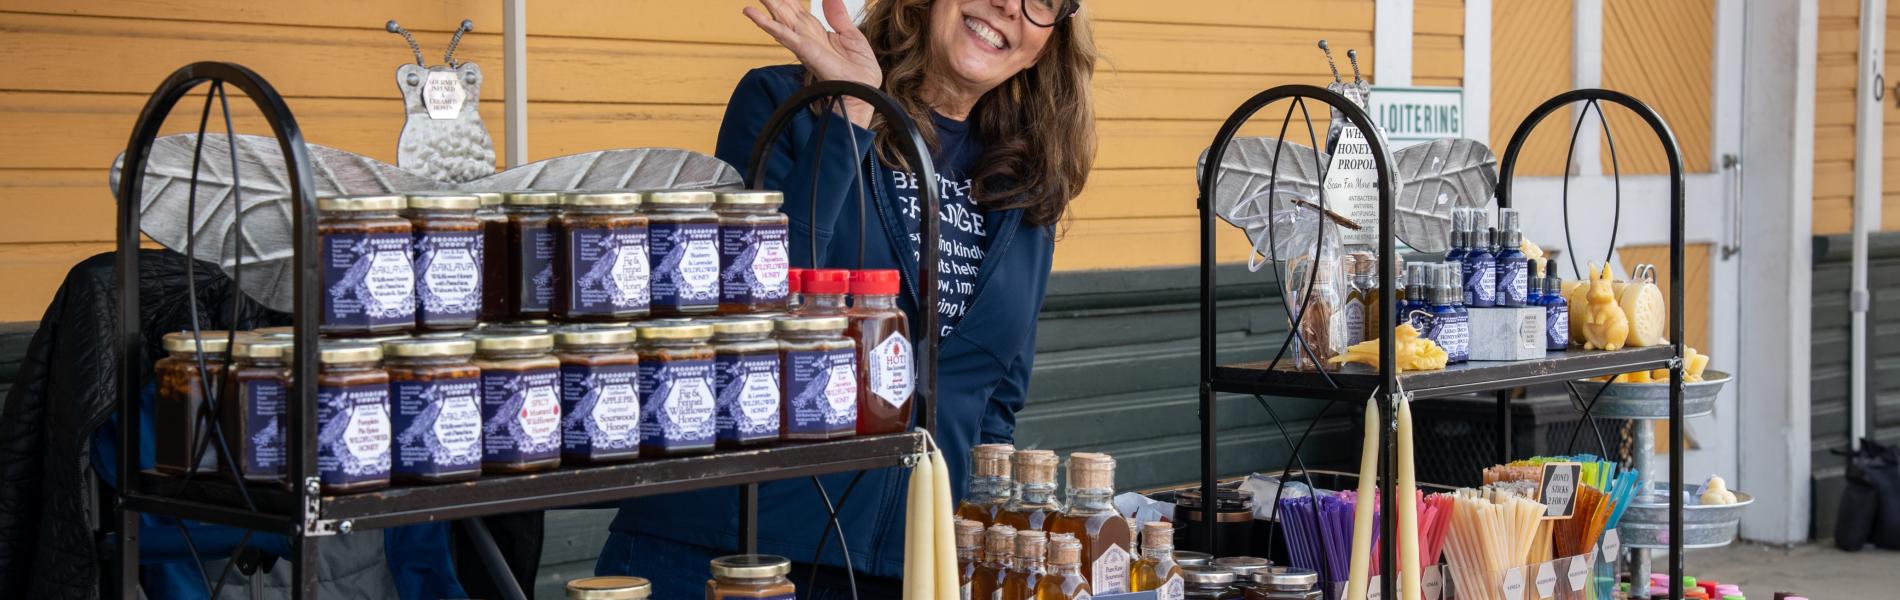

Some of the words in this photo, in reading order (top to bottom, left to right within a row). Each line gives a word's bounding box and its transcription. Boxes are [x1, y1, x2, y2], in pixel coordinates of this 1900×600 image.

[1379, 104, 1459, 133] LOITERING
[1337, 159, 1379, 170] PROPOL
[431, 263, 474, 272] BAKLAVA
[679, 389, 691, 399] Fig
[692, 389, 700, 398] &
[601, 396, 620, 405] APPLE
[669, 406, 712, 415] Wildflower
[599, 412, 636, 423] Sourwood
[678, 415, 703, 424] Honey
[606, 422, 629, 432] Honey
